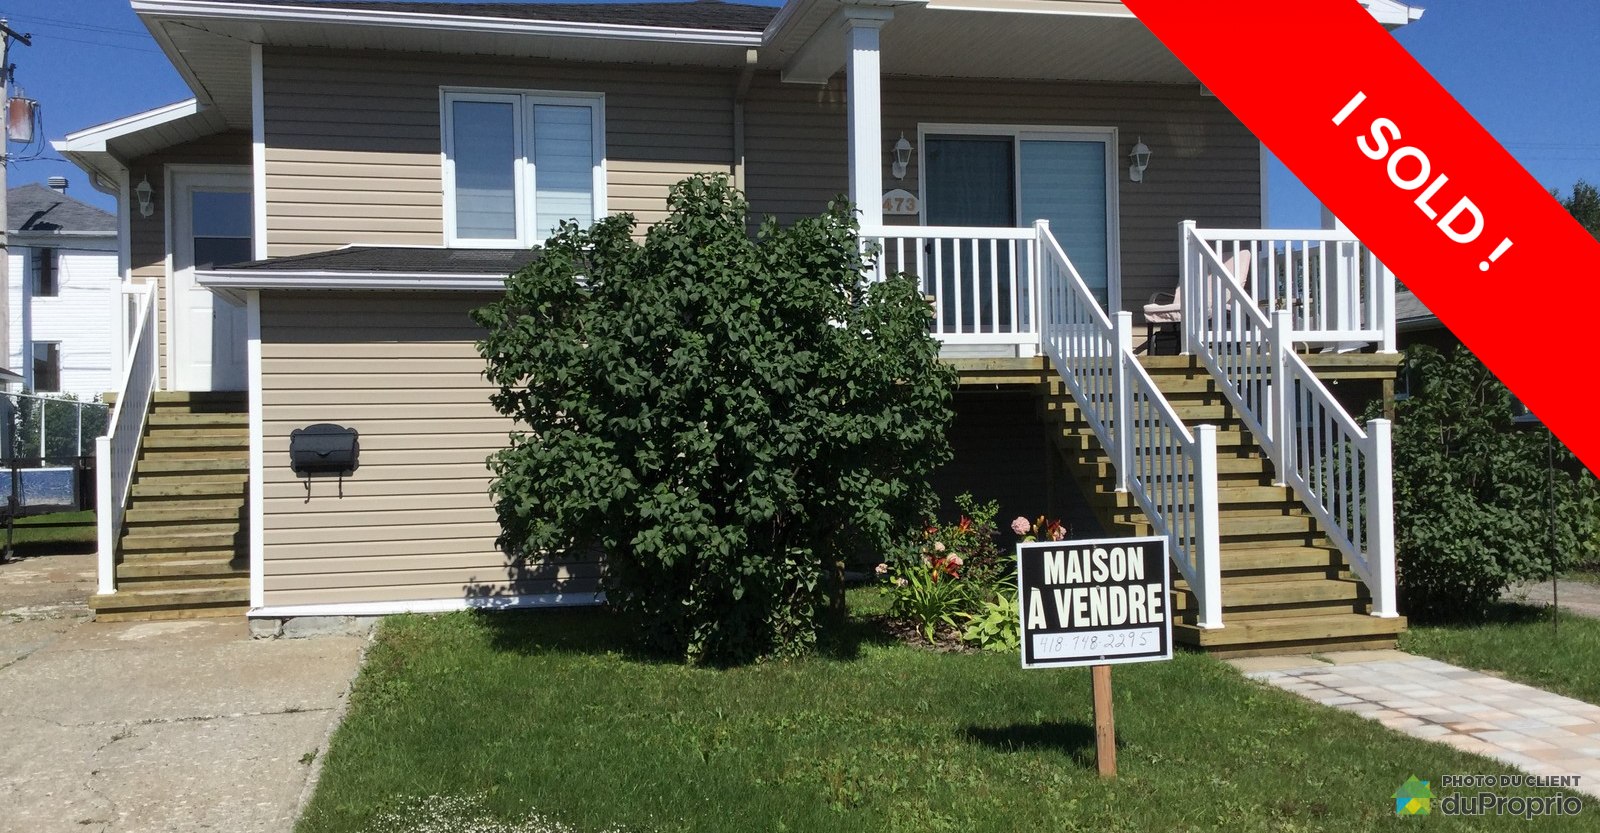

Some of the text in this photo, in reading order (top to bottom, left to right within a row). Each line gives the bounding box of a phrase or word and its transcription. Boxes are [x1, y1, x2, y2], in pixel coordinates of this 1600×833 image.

[882, 198, 916, 211] 473
[1044, 547, 1144, 584] MAISON
[1028, 584, 1163, 629] À VENDRE
[1040, 637, 1063, 652] 418
